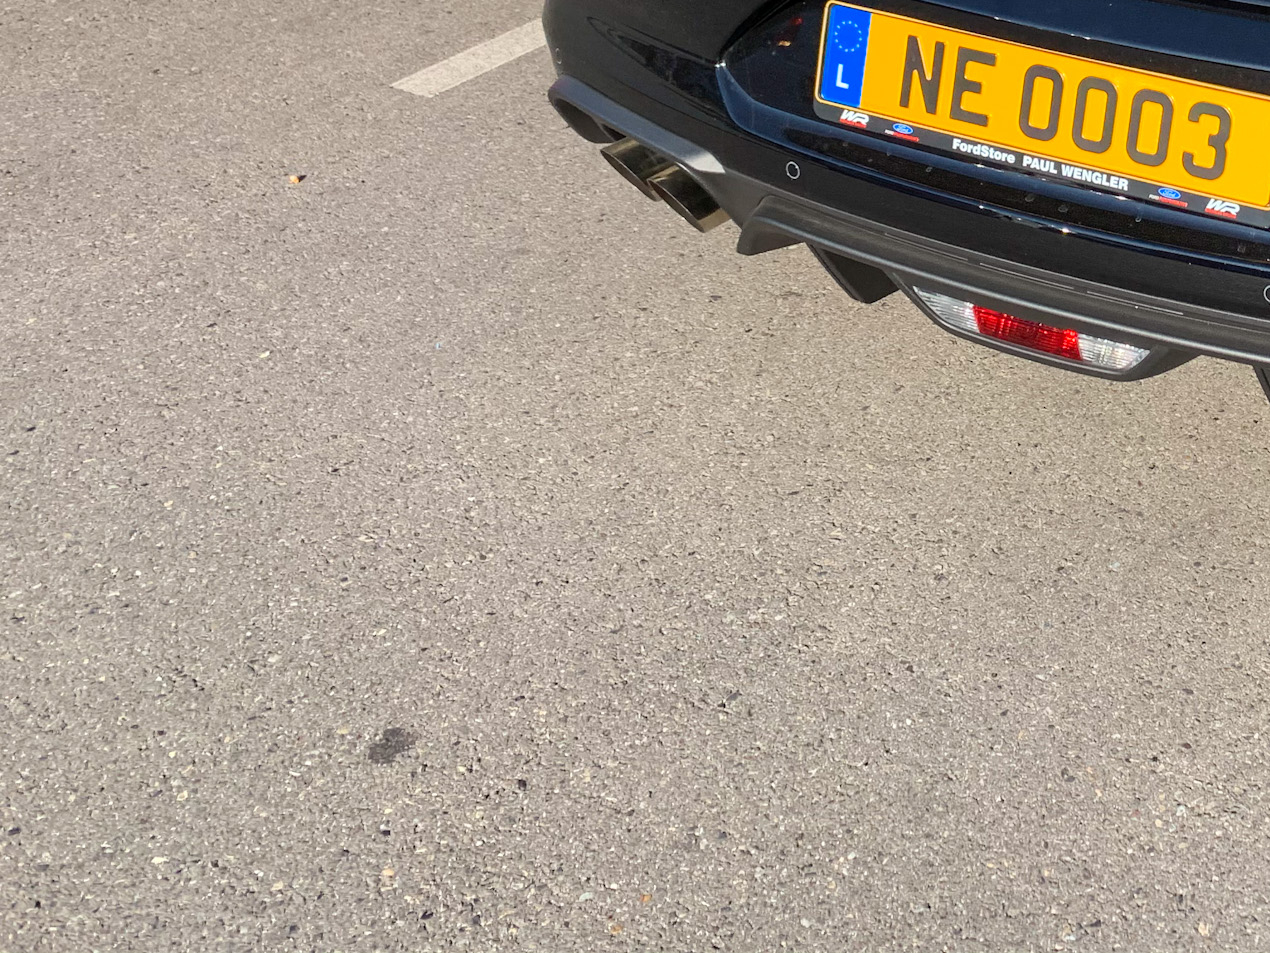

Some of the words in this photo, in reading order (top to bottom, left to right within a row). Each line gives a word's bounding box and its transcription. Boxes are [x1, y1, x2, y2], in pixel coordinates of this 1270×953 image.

[836, 63, 850, 90] L
[899, 34, 998, 128] NE
[1018, 63, 1232, 181] 0003
[952, 138, 1016, 163] FordStore
[1022, 155, 1058, 175] PAUL
[1060, 164, 1129, 191] WENGLER
